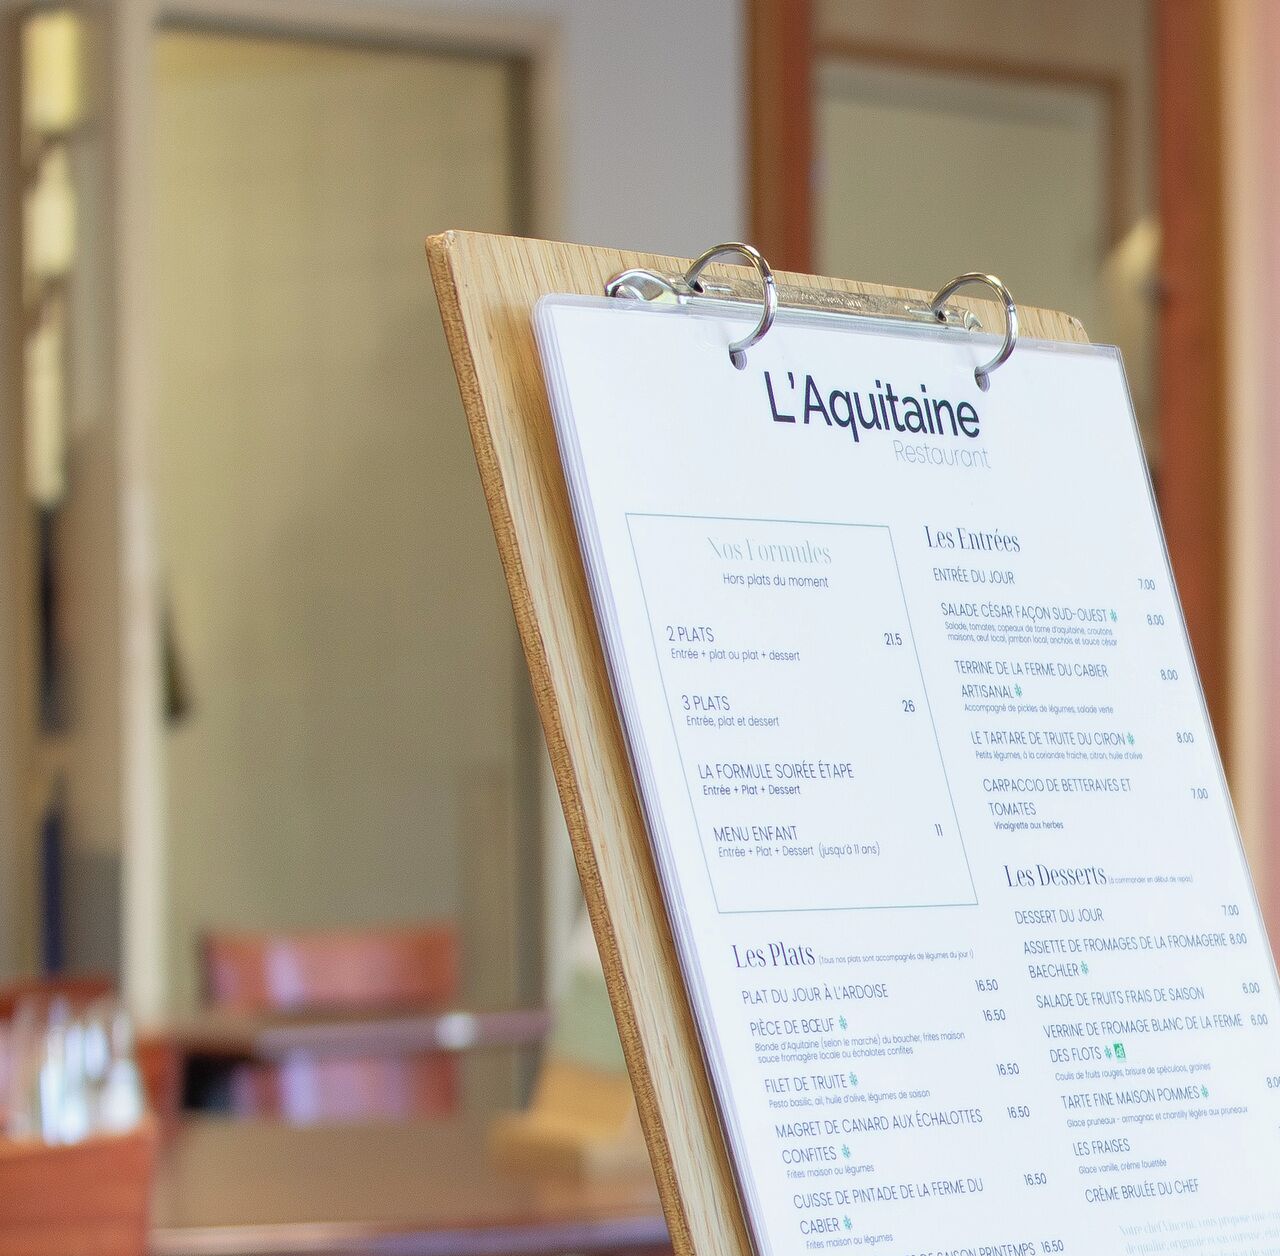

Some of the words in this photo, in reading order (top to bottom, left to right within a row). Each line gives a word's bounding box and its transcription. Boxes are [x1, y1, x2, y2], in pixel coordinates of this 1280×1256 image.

[764, 371, 981, 442] L'Aquitaine
[892, 440, 992, 470] Restaurant
[923, 525, 955, 549] Les
[956, 527, 1021, 552] Entrées
[723, 573, 745, 585] Hors
[747, 573, 771, 588] plats
[773, 574, 786, 586] du
[788, 577, 829, 588] moment
[933, 565, 969, 583] ENTRÉE
[970, 569, 986, 583] DU
[989, 570, 1015, 585] JOUR
[1137, 578, 1156, 591] 7.00
[940, 602, 979, 617] SALADE
[980, 601, 1014, 618] CÉSAR
[1015, 605, 1051, 624] FAÇON
[1052, 607, 1107, 622] SUD-OUEST
[1146, 614, 1165, 626] 8.00
[666, 625, 676, 642] 2
[677, 626, 715, 643] PLATS
[883, 632, 903, 646] 21.5
[954, 660, 994, 675] TERRINE
[995, 661, 1010, 675] DE
[1010, 662, 1024, 675] LA
[1024, 662, 1056, 676] FERME
[1057, 663, 1073, 677] DU
[1073, 663, 1109, 677] CABIER
[1160, 669, 1179, 681] 8.00
[681, 694, 691, 711] 3
[692, 695, 731, 711] PLATS
[901, 699, 916, 713] 26
[686, 715, 716, 727] Entrée,
[717, 715, 735, 729] plat
[737, 716, 746, 726] et
[747, 715, 780, 727] dessert
[970, 731, 982, 745] LE
[983, 731, 1027, 745] TARTARE
[1028, 731, 1043, 745] DE
[1042, 731, 1076, 746] TRUITE
[1077, 732, 1092, 746] DU
[1093, 732, 1126, 746] CIRON
[1176, 732, 1194, 743] 8.00
[697, 764, 714, 779] LA
[715, 763, 773, 779] FORMULE
[774, 760, 817, 779] SOIRÉE
[818, 760, 854, 779] ÉTAPE
[702, 784, 731, 796] Entrée
[741, 784, 758, 795] Plat
[768, 784, 801, 795] Dessert
[982, 778, 1045, 792] CARPACCIO
[1045, 778, 1060, 792] DE
[1061, 778, 1120, 792] BETTERAVES
[1120, 778, 1131, 792] ET
[1190, 788, 1209, 800] 7.00
[713, 826, 750, 842] MENU
[751, 825, 798, 841] ENFANT
[934, 823, 943, 837] 11
[1003, 865, 1035, 887] Les
[1035, 864, 1107, 886] Desserts
[1014, 909, 1057, 925] DESSERT
[1059, 909, 1075, 923] DU
[1077, 908, 1104, 922] JOUR
[1221, 904, 1239, 916] 7.00
[731, 944, 767, 968] Les
[767, 941, 816, 967] Plats
[741, 989, 768, 1005] PLAT
[770, 989, 789, 1003] DU
[792, 987, 822, 1002] JOUR
[824, 983, 833, 1000] À
[833, 983, 889, 1000] L'ARDOISE
[975, 979, 999, 992] 16.50
[1036, 993, 1075, 1009] SALADE
[1075, 992, 1090, 1006] DE
[1090, 990, 1124, 1005] FRUITS
[1124, 989, 1153, 1003] FRAIS
[1153, 988, 1167, 1002] DE
[1168, 986, 1205, 1001] SAISON
[1242, 982, 1260, 994] 6.00
[749, 1018, 782, 1036] PIÈCE
[783, 1019, 800, 1034] DE
[801, 1017, 834, 1034] BŒUF
[982, 1008, 1006, 1022] 16.50
[764, 1077, 790, 1093] FILET
[793, 1076, 810, 1092] DE
[810, 1074, 848, 1090] TRUITE
[996, 1063, 1020, 1076] 16.50
[1060, 1093, 1092, 1109] TARTE
[1093, 1092, 1115, 1107] FINE
[1115, 1089, 1156, 1105] MAISON
[1156, 1085, 1200, 1101] POMMES
[775, 1121, 821, 1138] MAGRET
[824, 1119, 841, 1135] DE
[841, 1115, 889, 1133] CANARD
[893, 1114, 915, 1129] AUX
[915, 1108, 983, 1128] ÉCHALOTTES
[1007, 1105, 1030, 1119] 16.50
[782, 1146, 837, 1164] CONFITES
[1072, 1141, 1090, 1156] LES
[1091, 1138, 1131, 1154] FRAISES
[793, 1191, 834, 1209] CUISSE
[834, 1190, 851, 1205] DE
[852, 1185, 899, 1203] PINTADE
[899, 1183, 915, 1199] DE
[916, 1183, 931, 1198] LA
[931, 1179, 966, 1196] FERME
[966, 1178, 984, 1193] DU
[1023, 1172, 1047, 1186] 16.50
[1085, 1185, 1120, 1203] CRÈME
[1120, 1180, 1156, 1199] BRULÉE
[1157, 1181, 1173, 1196] DU
[1174, 1178, 1199, 1194] CHEF
[799, 1217, 841, 1235] CABIER
[1040, 1239, 1064, 1253] 16.50
